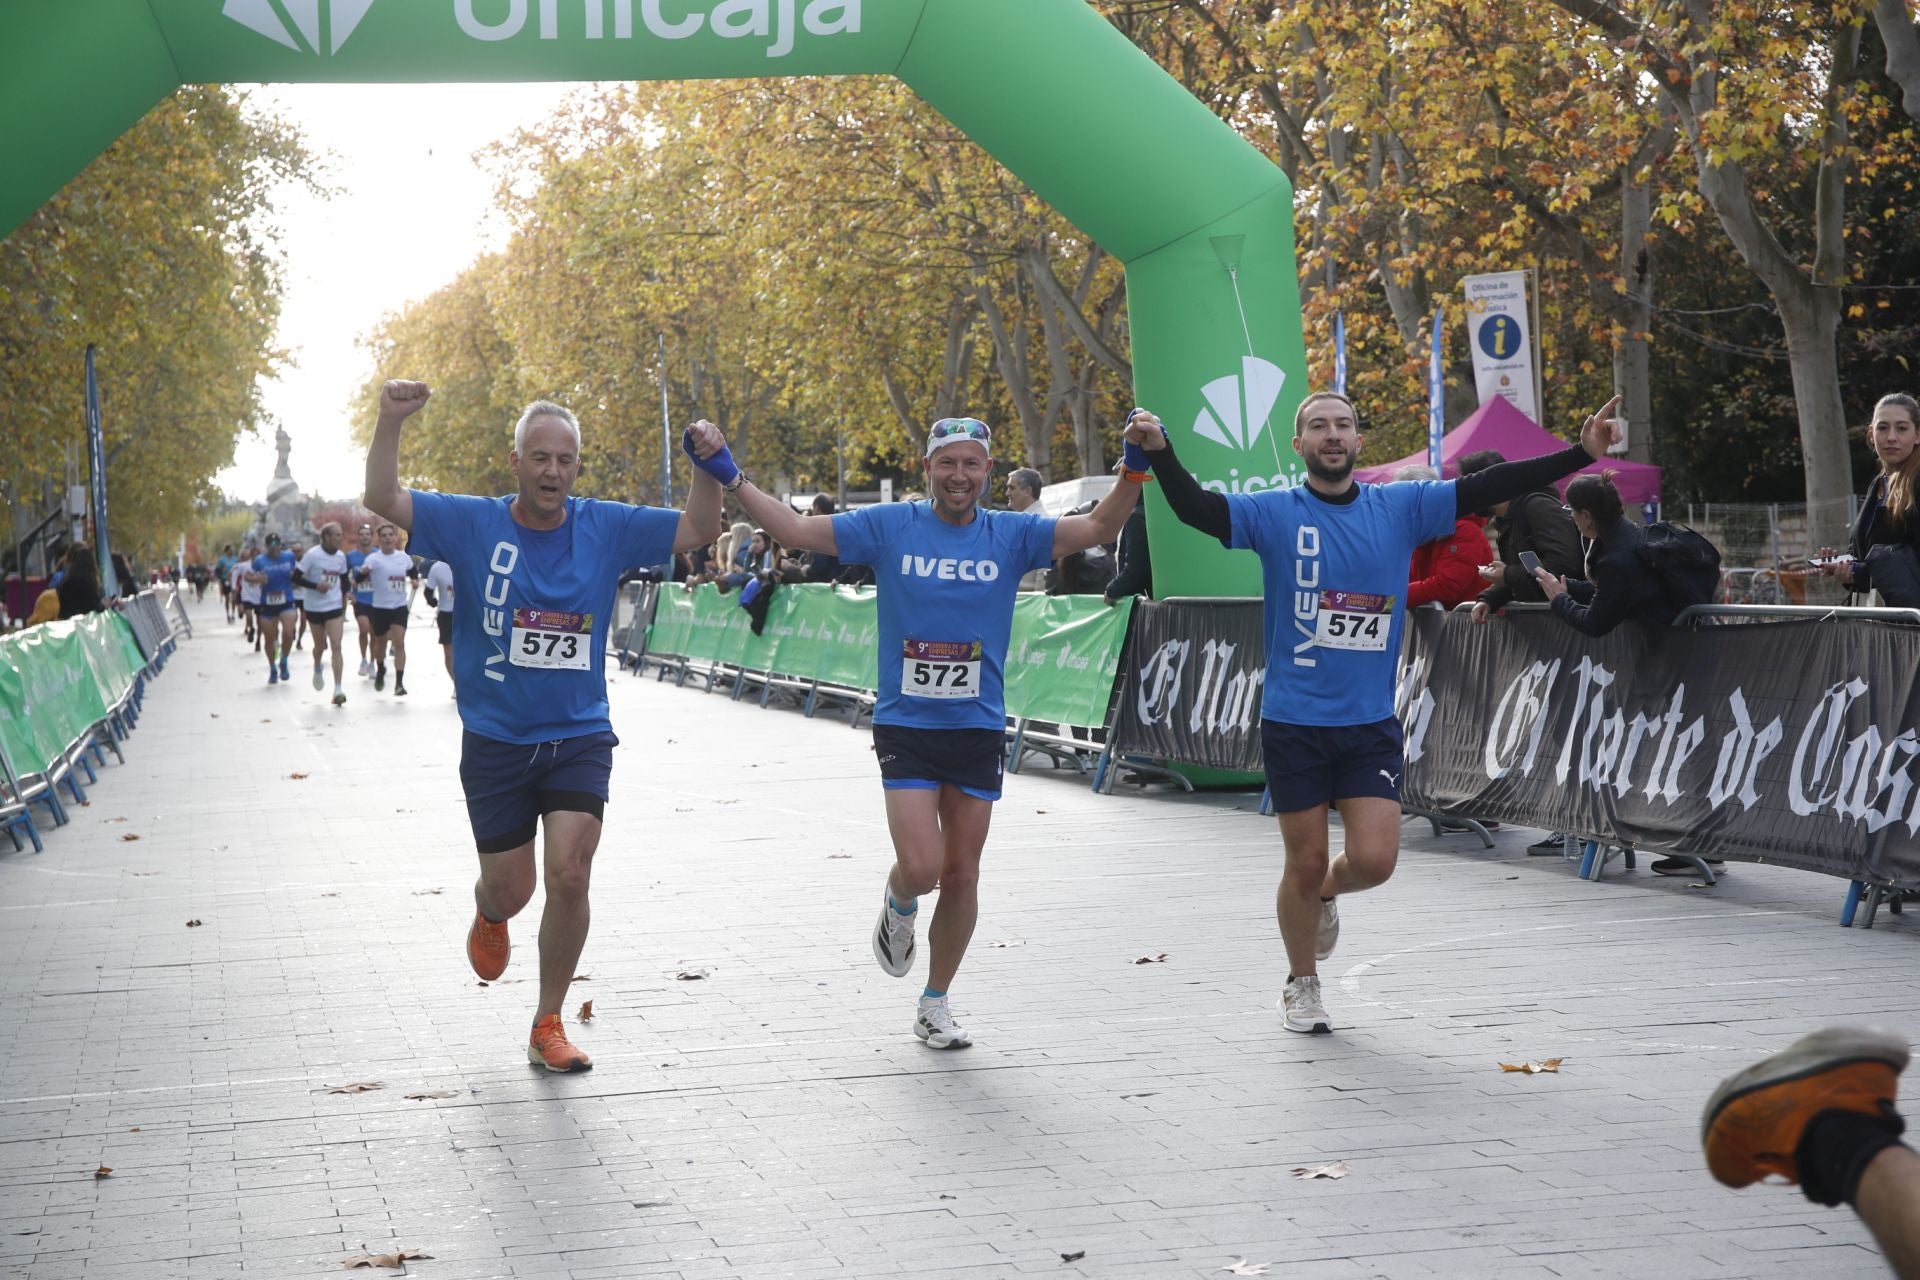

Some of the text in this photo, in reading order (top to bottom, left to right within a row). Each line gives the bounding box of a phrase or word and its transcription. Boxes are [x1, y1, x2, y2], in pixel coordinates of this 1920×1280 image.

[1472, 281, 1508, 292] Oficina de
[901, 554, 999, 582] IVECO
[1293, 525, 1320, 668] IVECO
[482, 541, 519, 682] IVECO
[1328, 613, 1380, 639] 574
[522, 631, 578, 659] 573
[913, 662, 969, 687] 572
[1190, 638, 1265, 735] Nor
[1485, 657, 1561, 781] El
[1555, 655, 1705, 807] Norte
[1706, 686, 1783, 812] de
[1788, 675, 1920, 840] Cas
